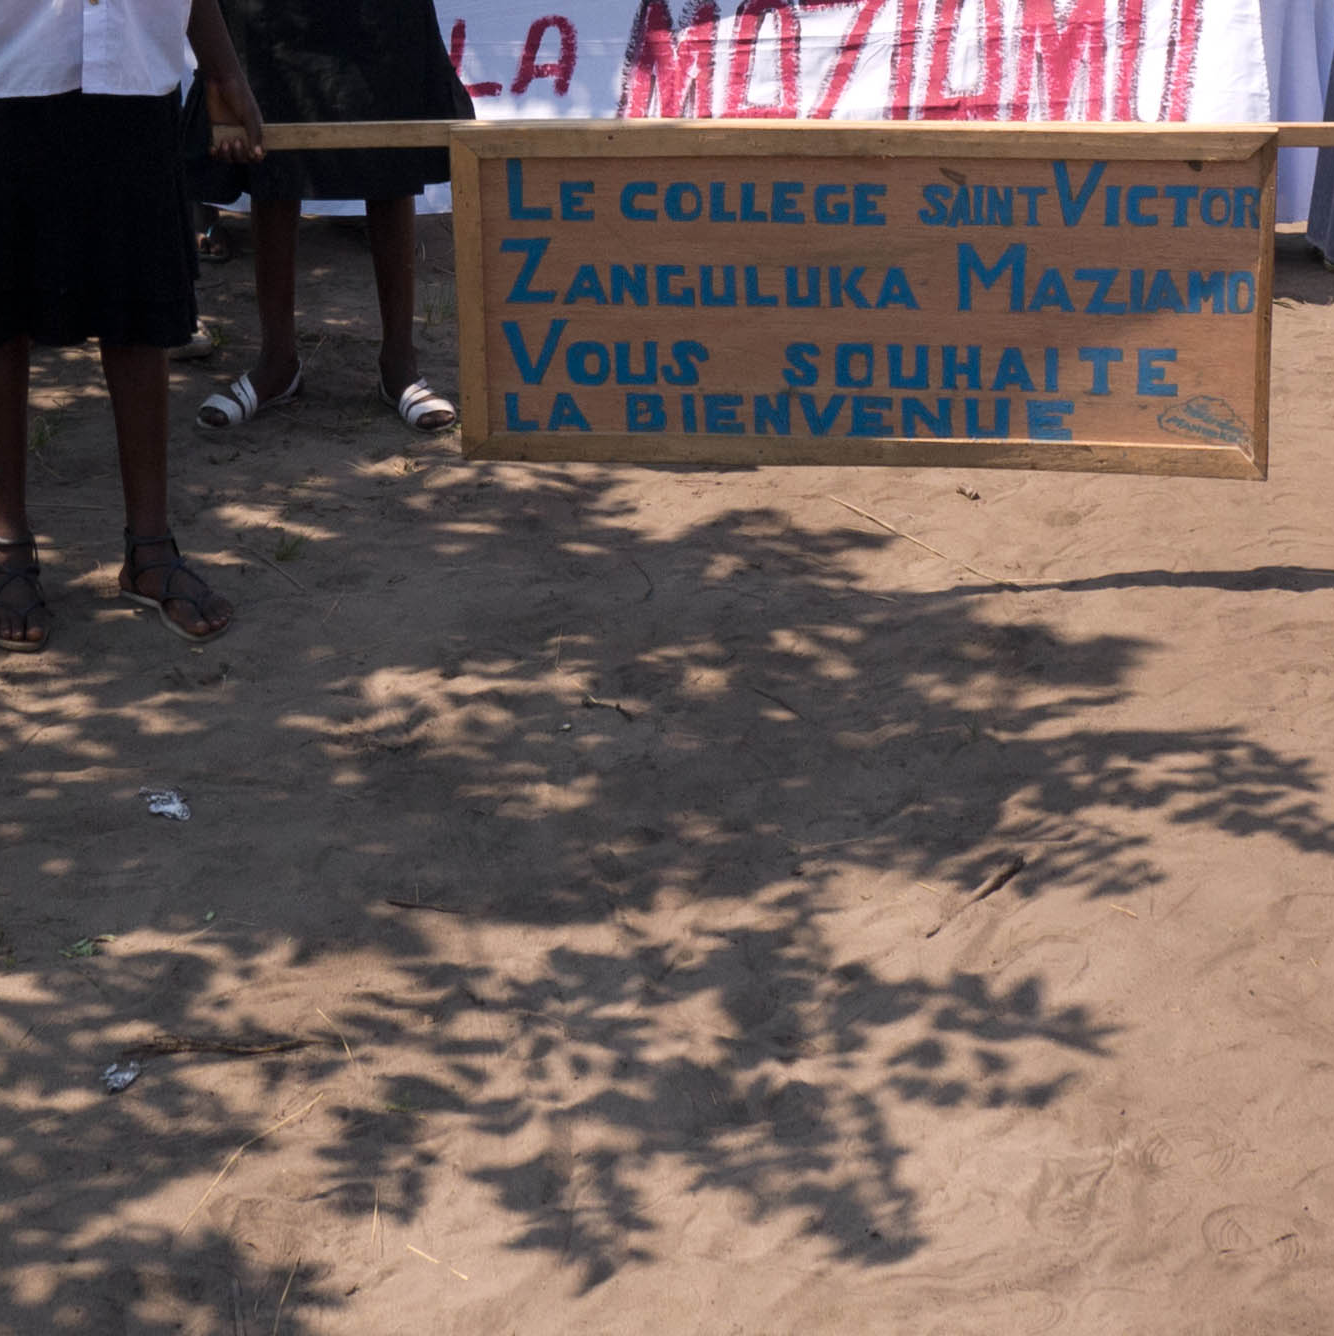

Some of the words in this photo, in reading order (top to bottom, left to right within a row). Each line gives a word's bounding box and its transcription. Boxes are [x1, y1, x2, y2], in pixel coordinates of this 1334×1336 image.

[505, 158, 595, 221] LE
[620, 182, 887, 226] COLLEGE
[918, 185, 1048, 228] SAINT
[1052, 161, 1260, 229] VICTOR
[500, 237, 920, 310] ZANGULUKA
[957, 242, 1255, 315] MAZIAMO
[501, 319, 710, 387] VOUS
[782, 341, 1179, 398] SOUHAITE
[505, 393, 592, 433] LA
[626, 393, 1076, 441] BIENVENUE
